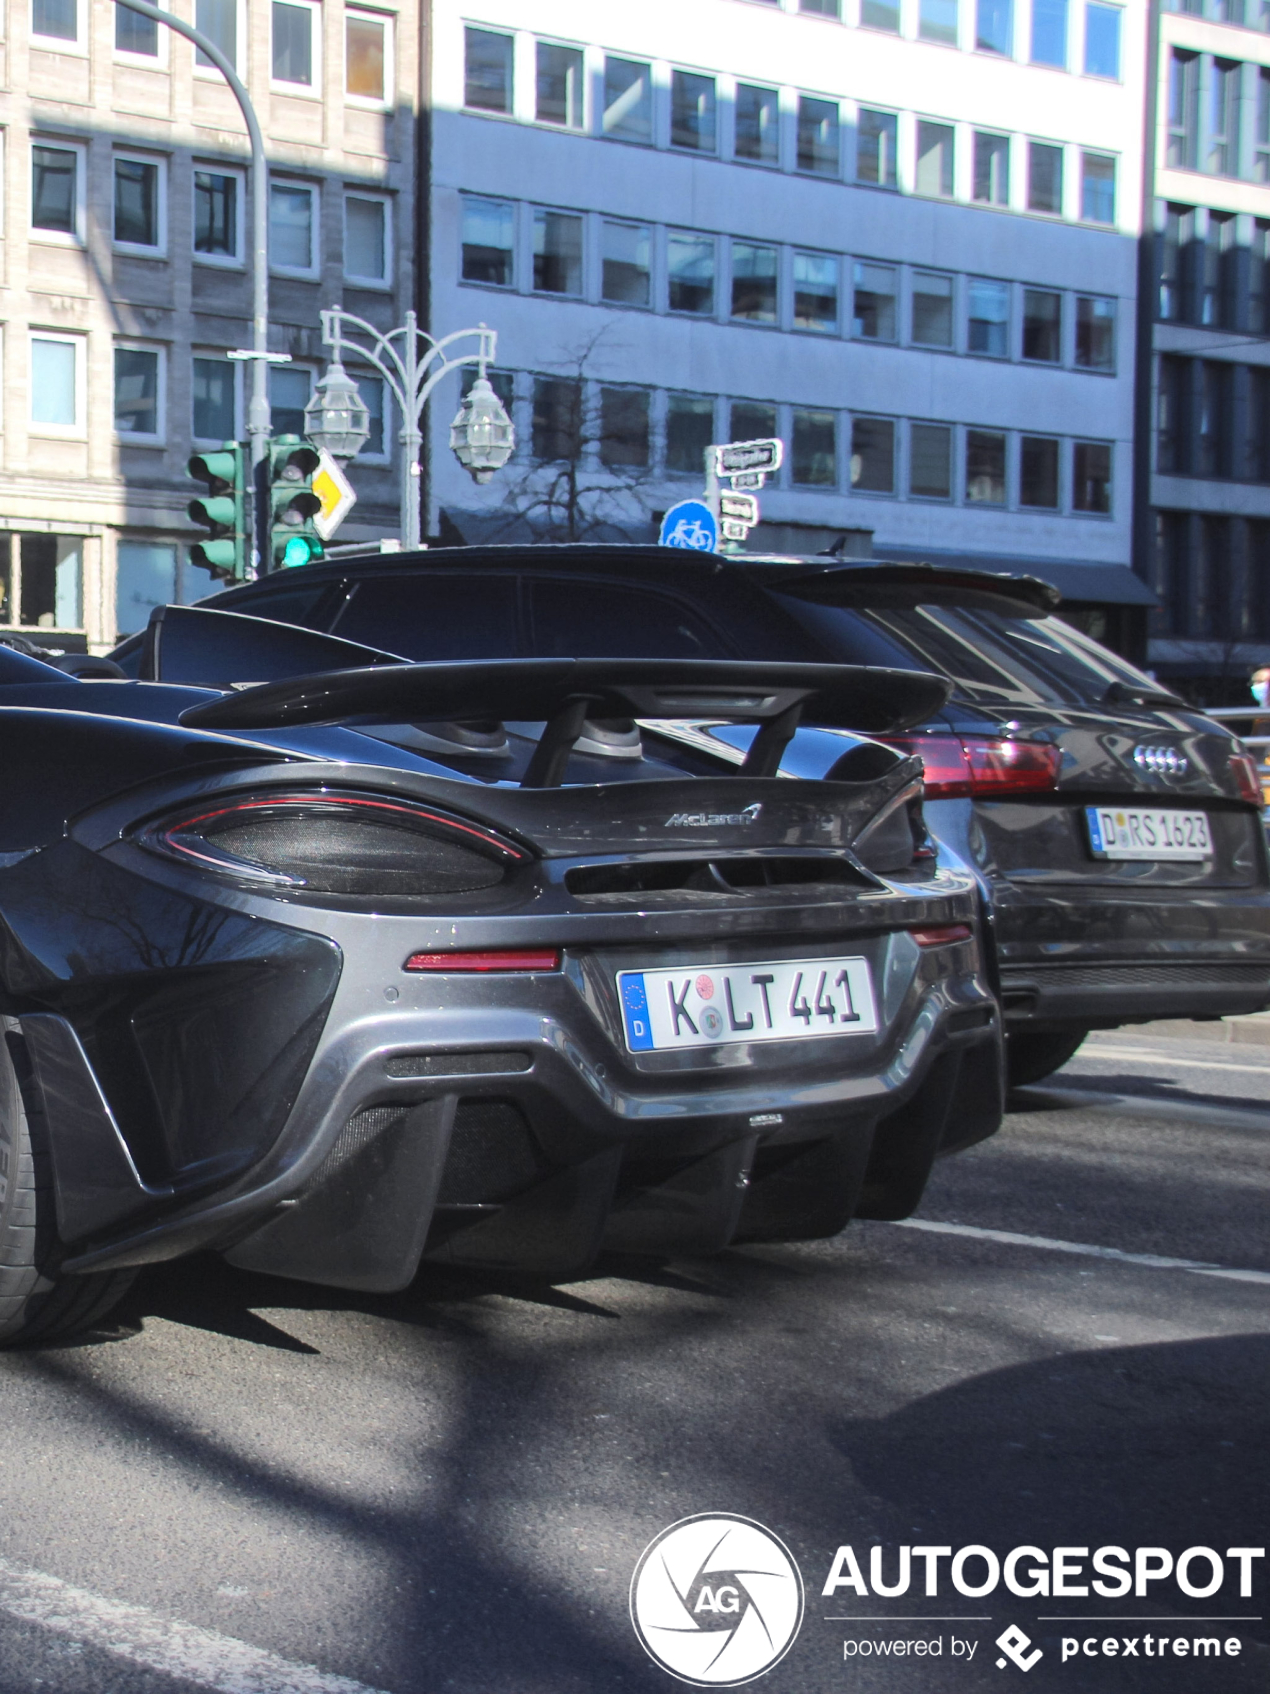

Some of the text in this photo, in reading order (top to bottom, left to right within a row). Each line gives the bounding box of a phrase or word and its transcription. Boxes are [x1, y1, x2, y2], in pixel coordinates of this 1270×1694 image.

[664, 812, 751, 827] McLaren
[1100, 813, 1207, 848] D RS 1623
[665, 969, 860, 1036] K LT 441
[633, 1020, 644, 1037] D
